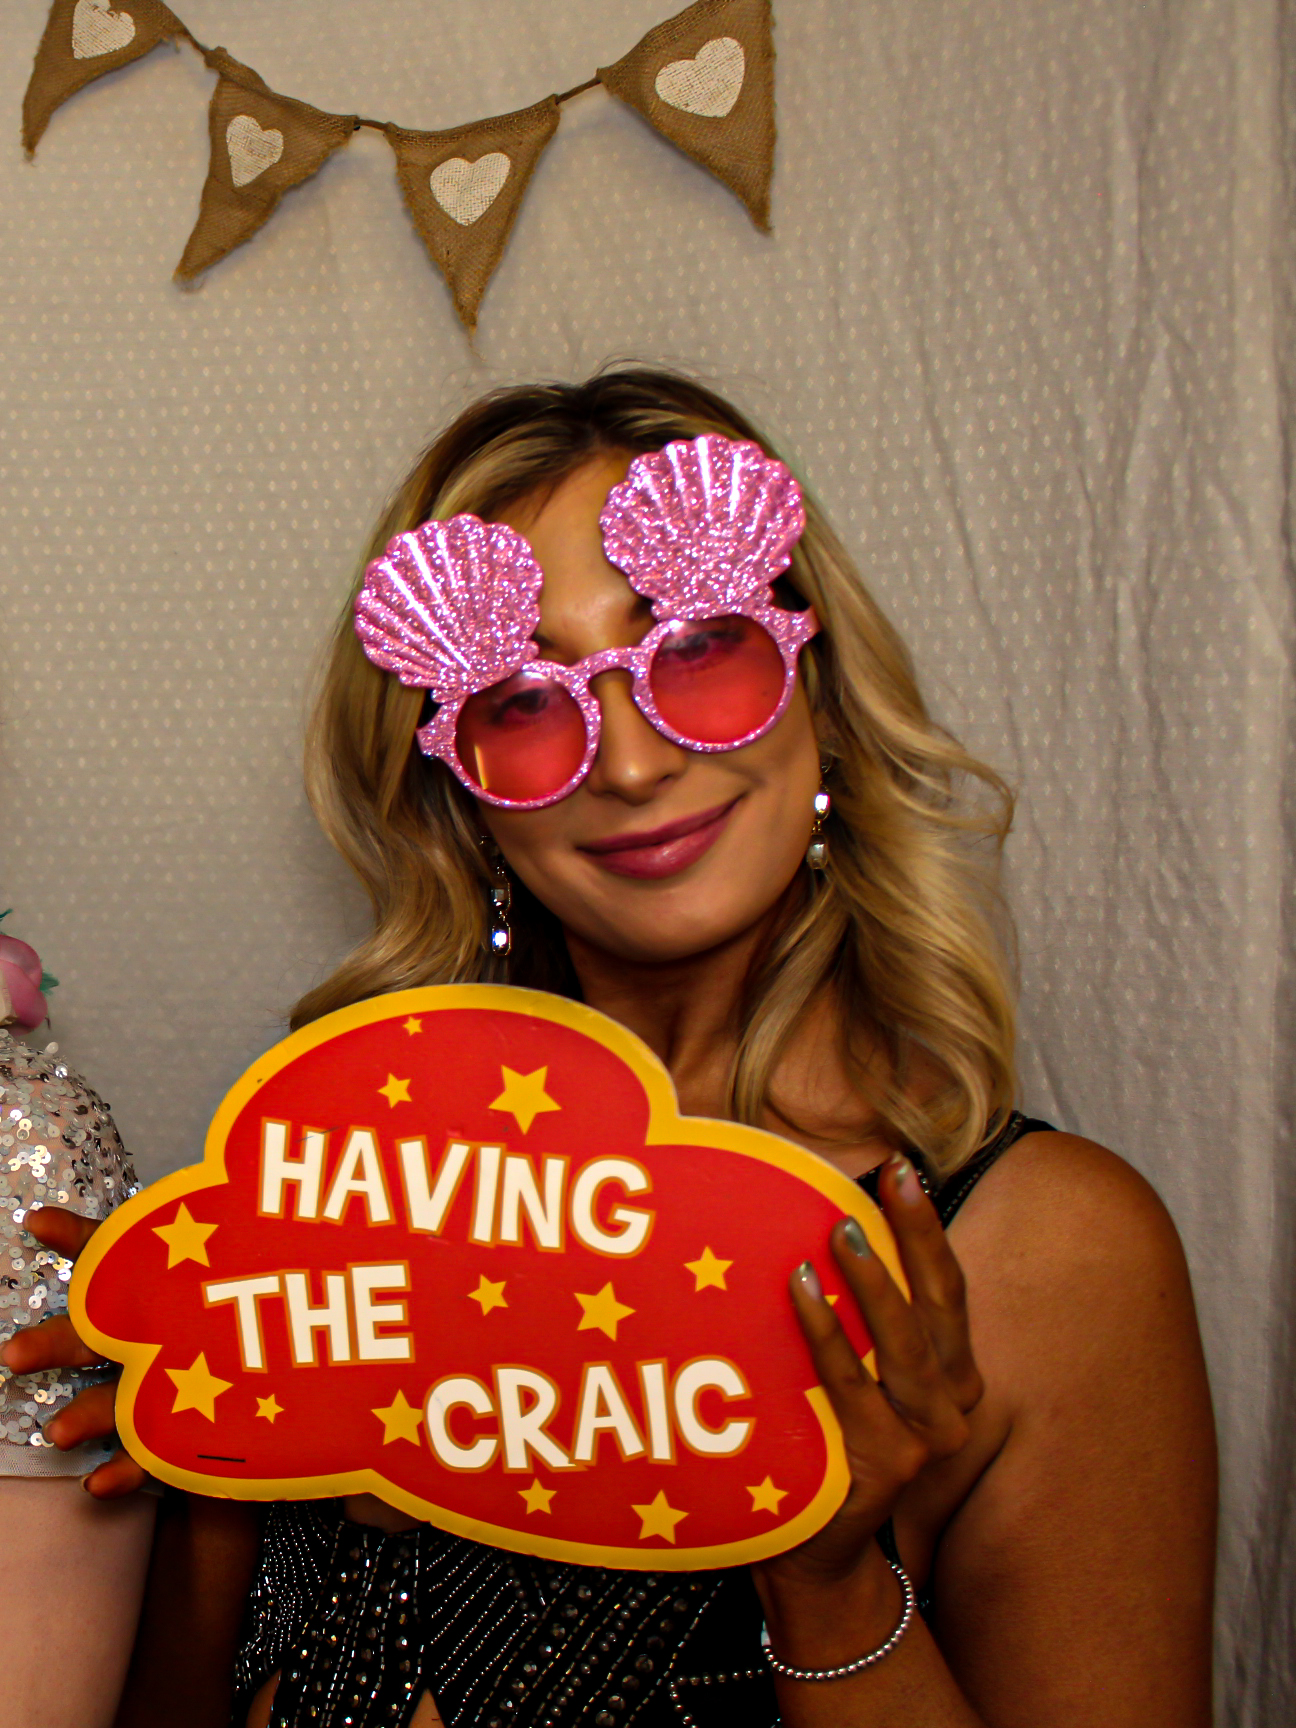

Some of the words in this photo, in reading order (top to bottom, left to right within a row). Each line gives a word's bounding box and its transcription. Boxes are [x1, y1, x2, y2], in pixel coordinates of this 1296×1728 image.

[260, 1120, 652, 1255] HAVING
[205, 1264, 412, 1369] THE
[424, 1359, 750, 1469] CRAIC
